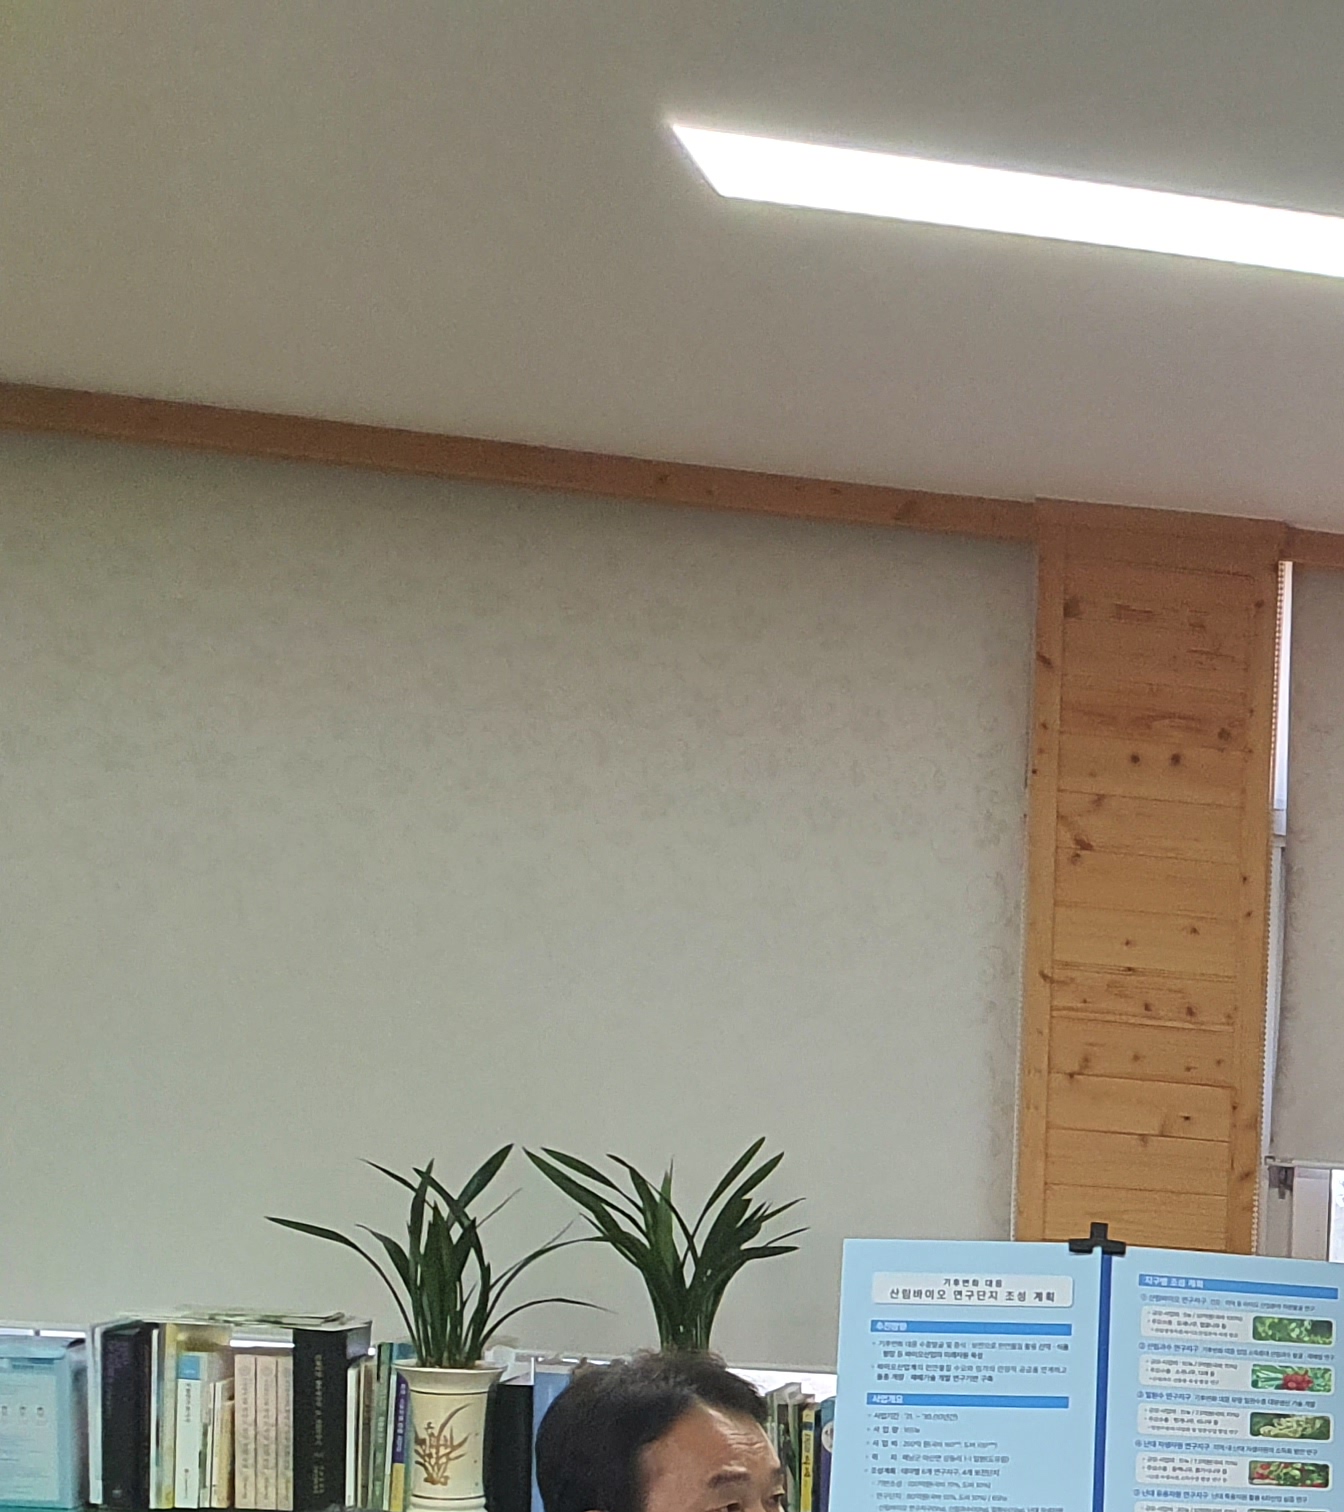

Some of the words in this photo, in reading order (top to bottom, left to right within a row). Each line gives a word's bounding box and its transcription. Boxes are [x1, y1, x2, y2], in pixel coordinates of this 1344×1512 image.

[943, 1278, 979, 1288] 기후변화
[985, 1279, 1003, 1288] 대응
[890, 1288, 947, 1300] 산림바이오
[953, 1290, 999, 1301] 연구단지
[1005, 1291, 1027, 1302] 조성
[1033, 1291, 1055, 1303] 계획
